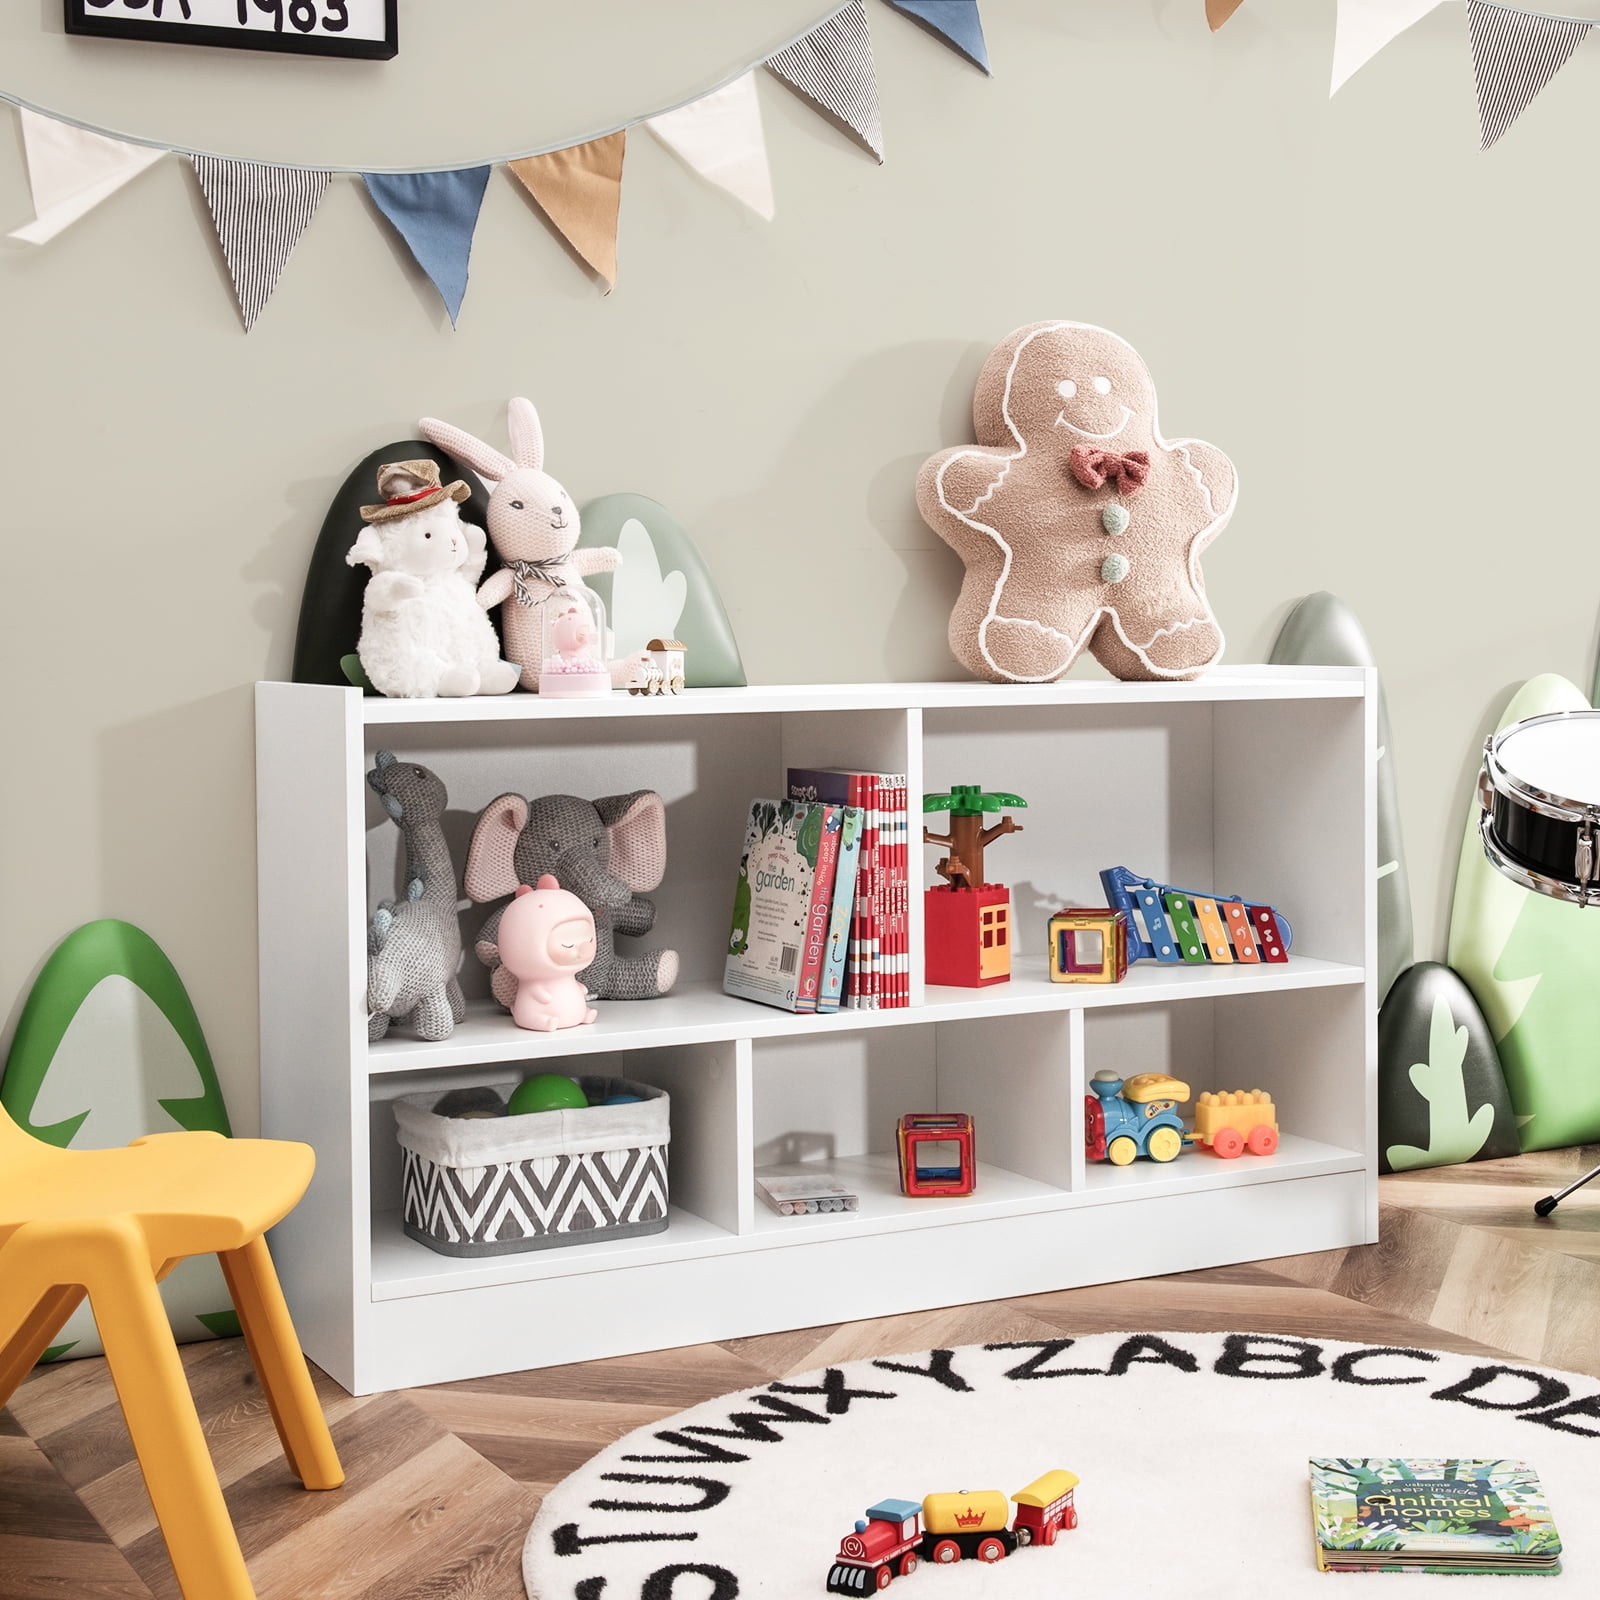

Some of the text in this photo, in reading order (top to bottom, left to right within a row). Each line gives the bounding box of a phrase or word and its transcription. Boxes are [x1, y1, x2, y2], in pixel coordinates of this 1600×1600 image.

[830, 835, 838, 864] usborne
[755, 867, 795, 893] garden
[816, 864, 828, 886] inside
[819, 887, 829, 902] the
[807, 903, 828, 966] garden
[1380, 1486, 1478, 1496] peep inside
[1364, 1494, 1492, 1507] animal
[1379, 1503, 1492, 1518] homes
[847, 1542, 859, 1551] CV
